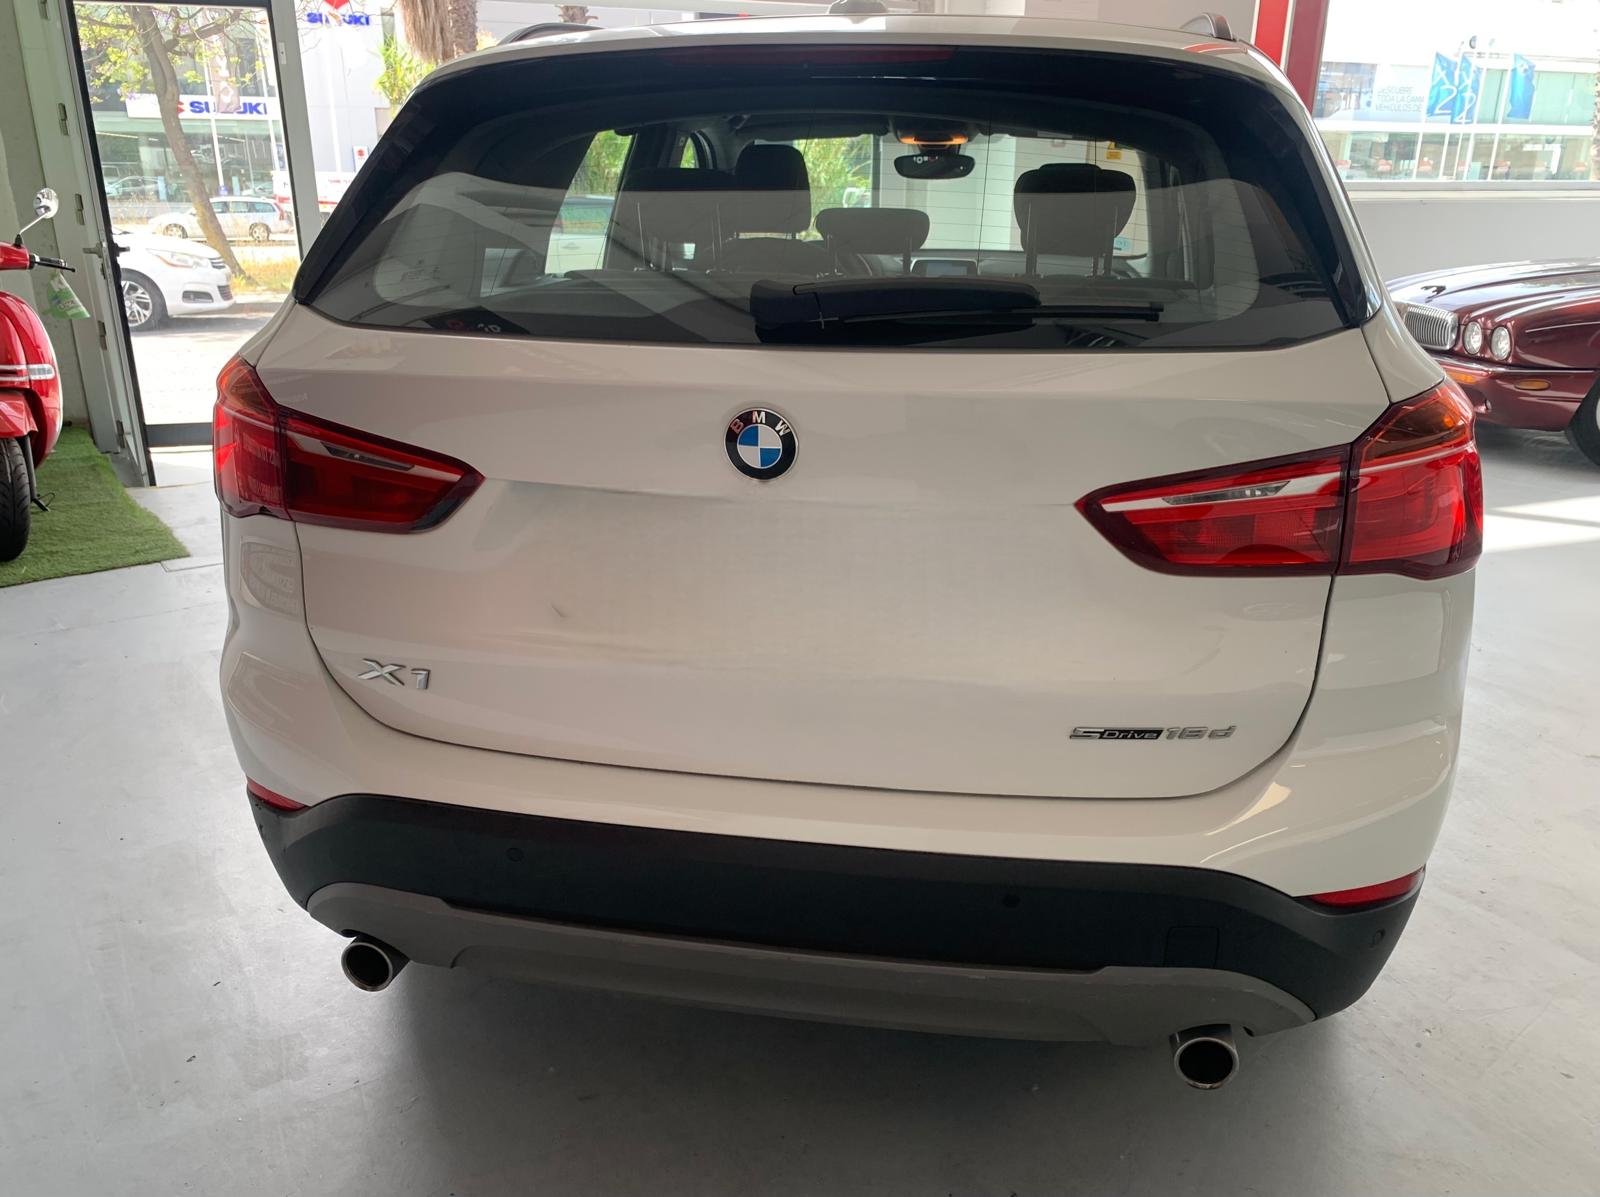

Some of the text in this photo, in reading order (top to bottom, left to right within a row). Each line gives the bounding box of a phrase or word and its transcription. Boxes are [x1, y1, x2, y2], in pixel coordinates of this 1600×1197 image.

[306, 12, 370, 26] SUUKI
[189, 100, 268, 116] SUUKI
[730, 409, 791, 437] BMW
[357, 658, 431, 689] X1
